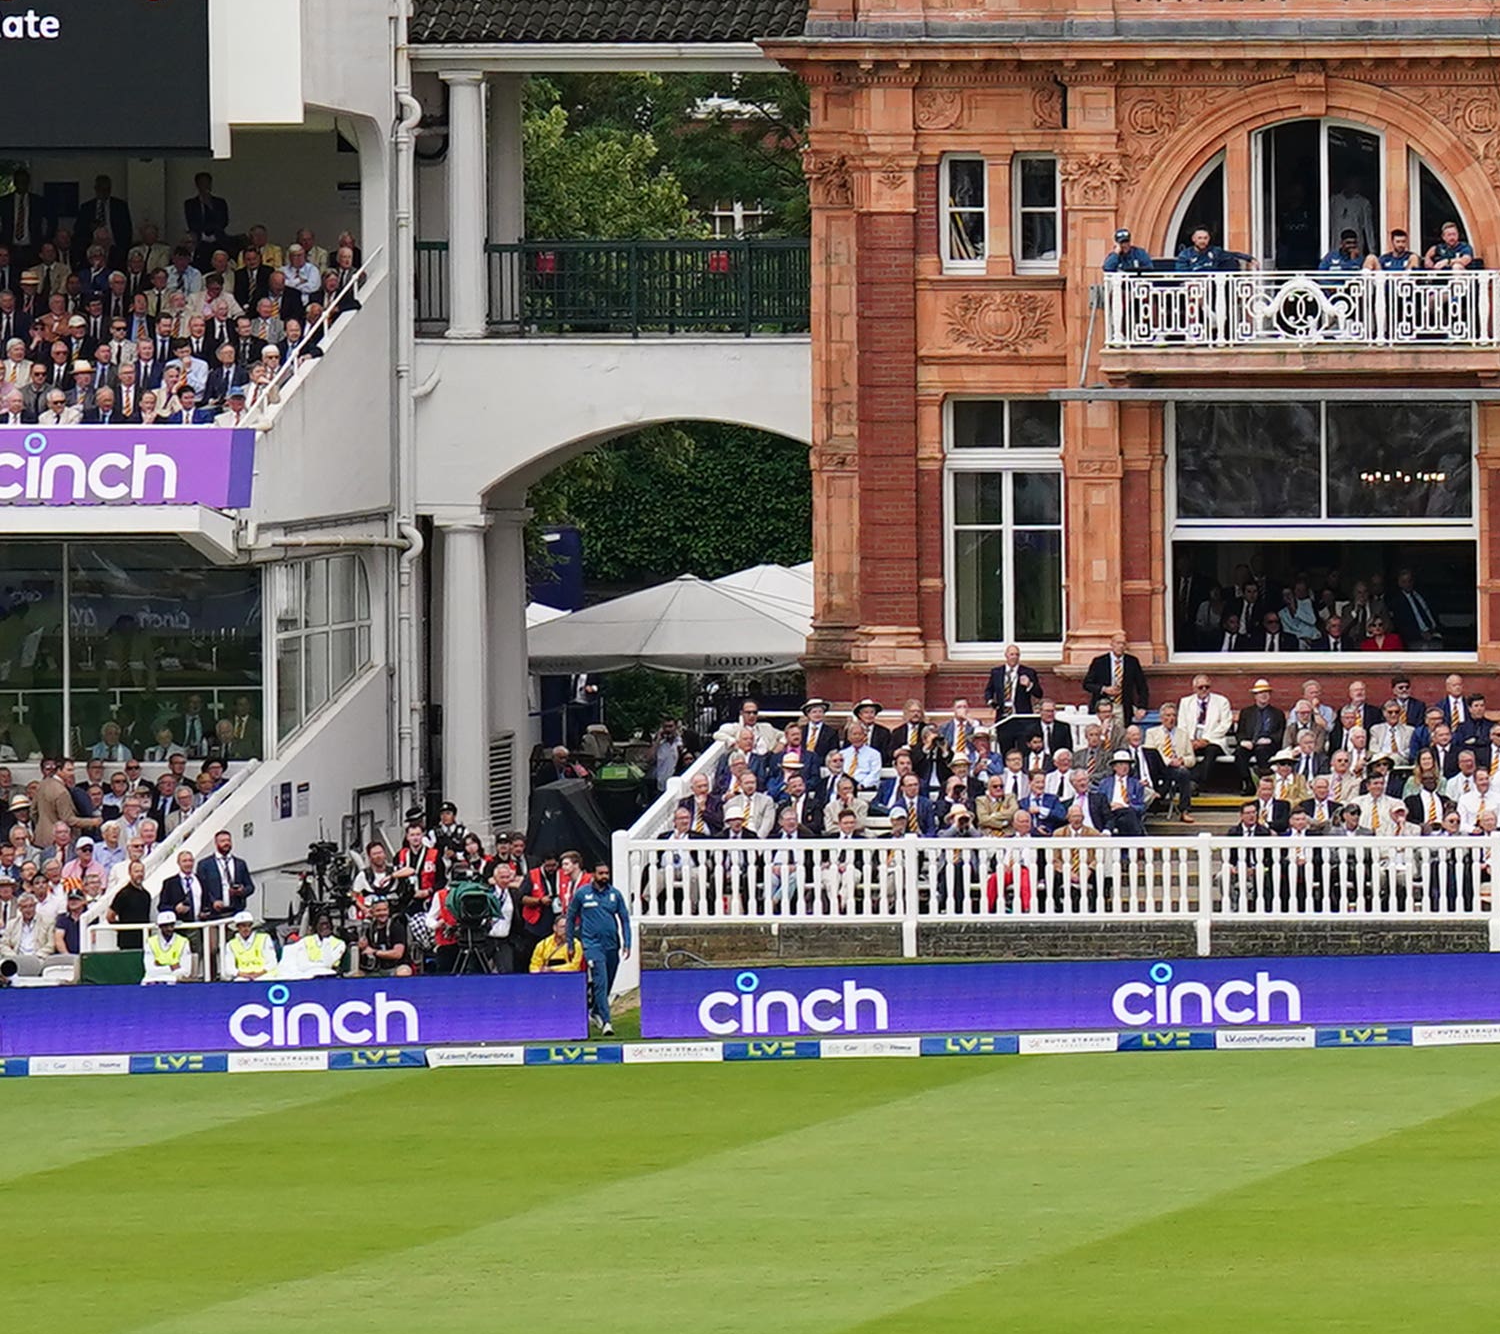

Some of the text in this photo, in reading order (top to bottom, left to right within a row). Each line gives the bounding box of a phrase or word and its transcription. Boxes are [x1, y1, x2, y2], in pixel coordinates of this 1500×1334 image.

[0, 10, 60, 39] ate
[0, 433, 177, 500] cinch
[229, 984, 419, 1047] cinch
[699, 972, 888, 1034] cinch
[1113, 963, 1300, 1025] cinch
